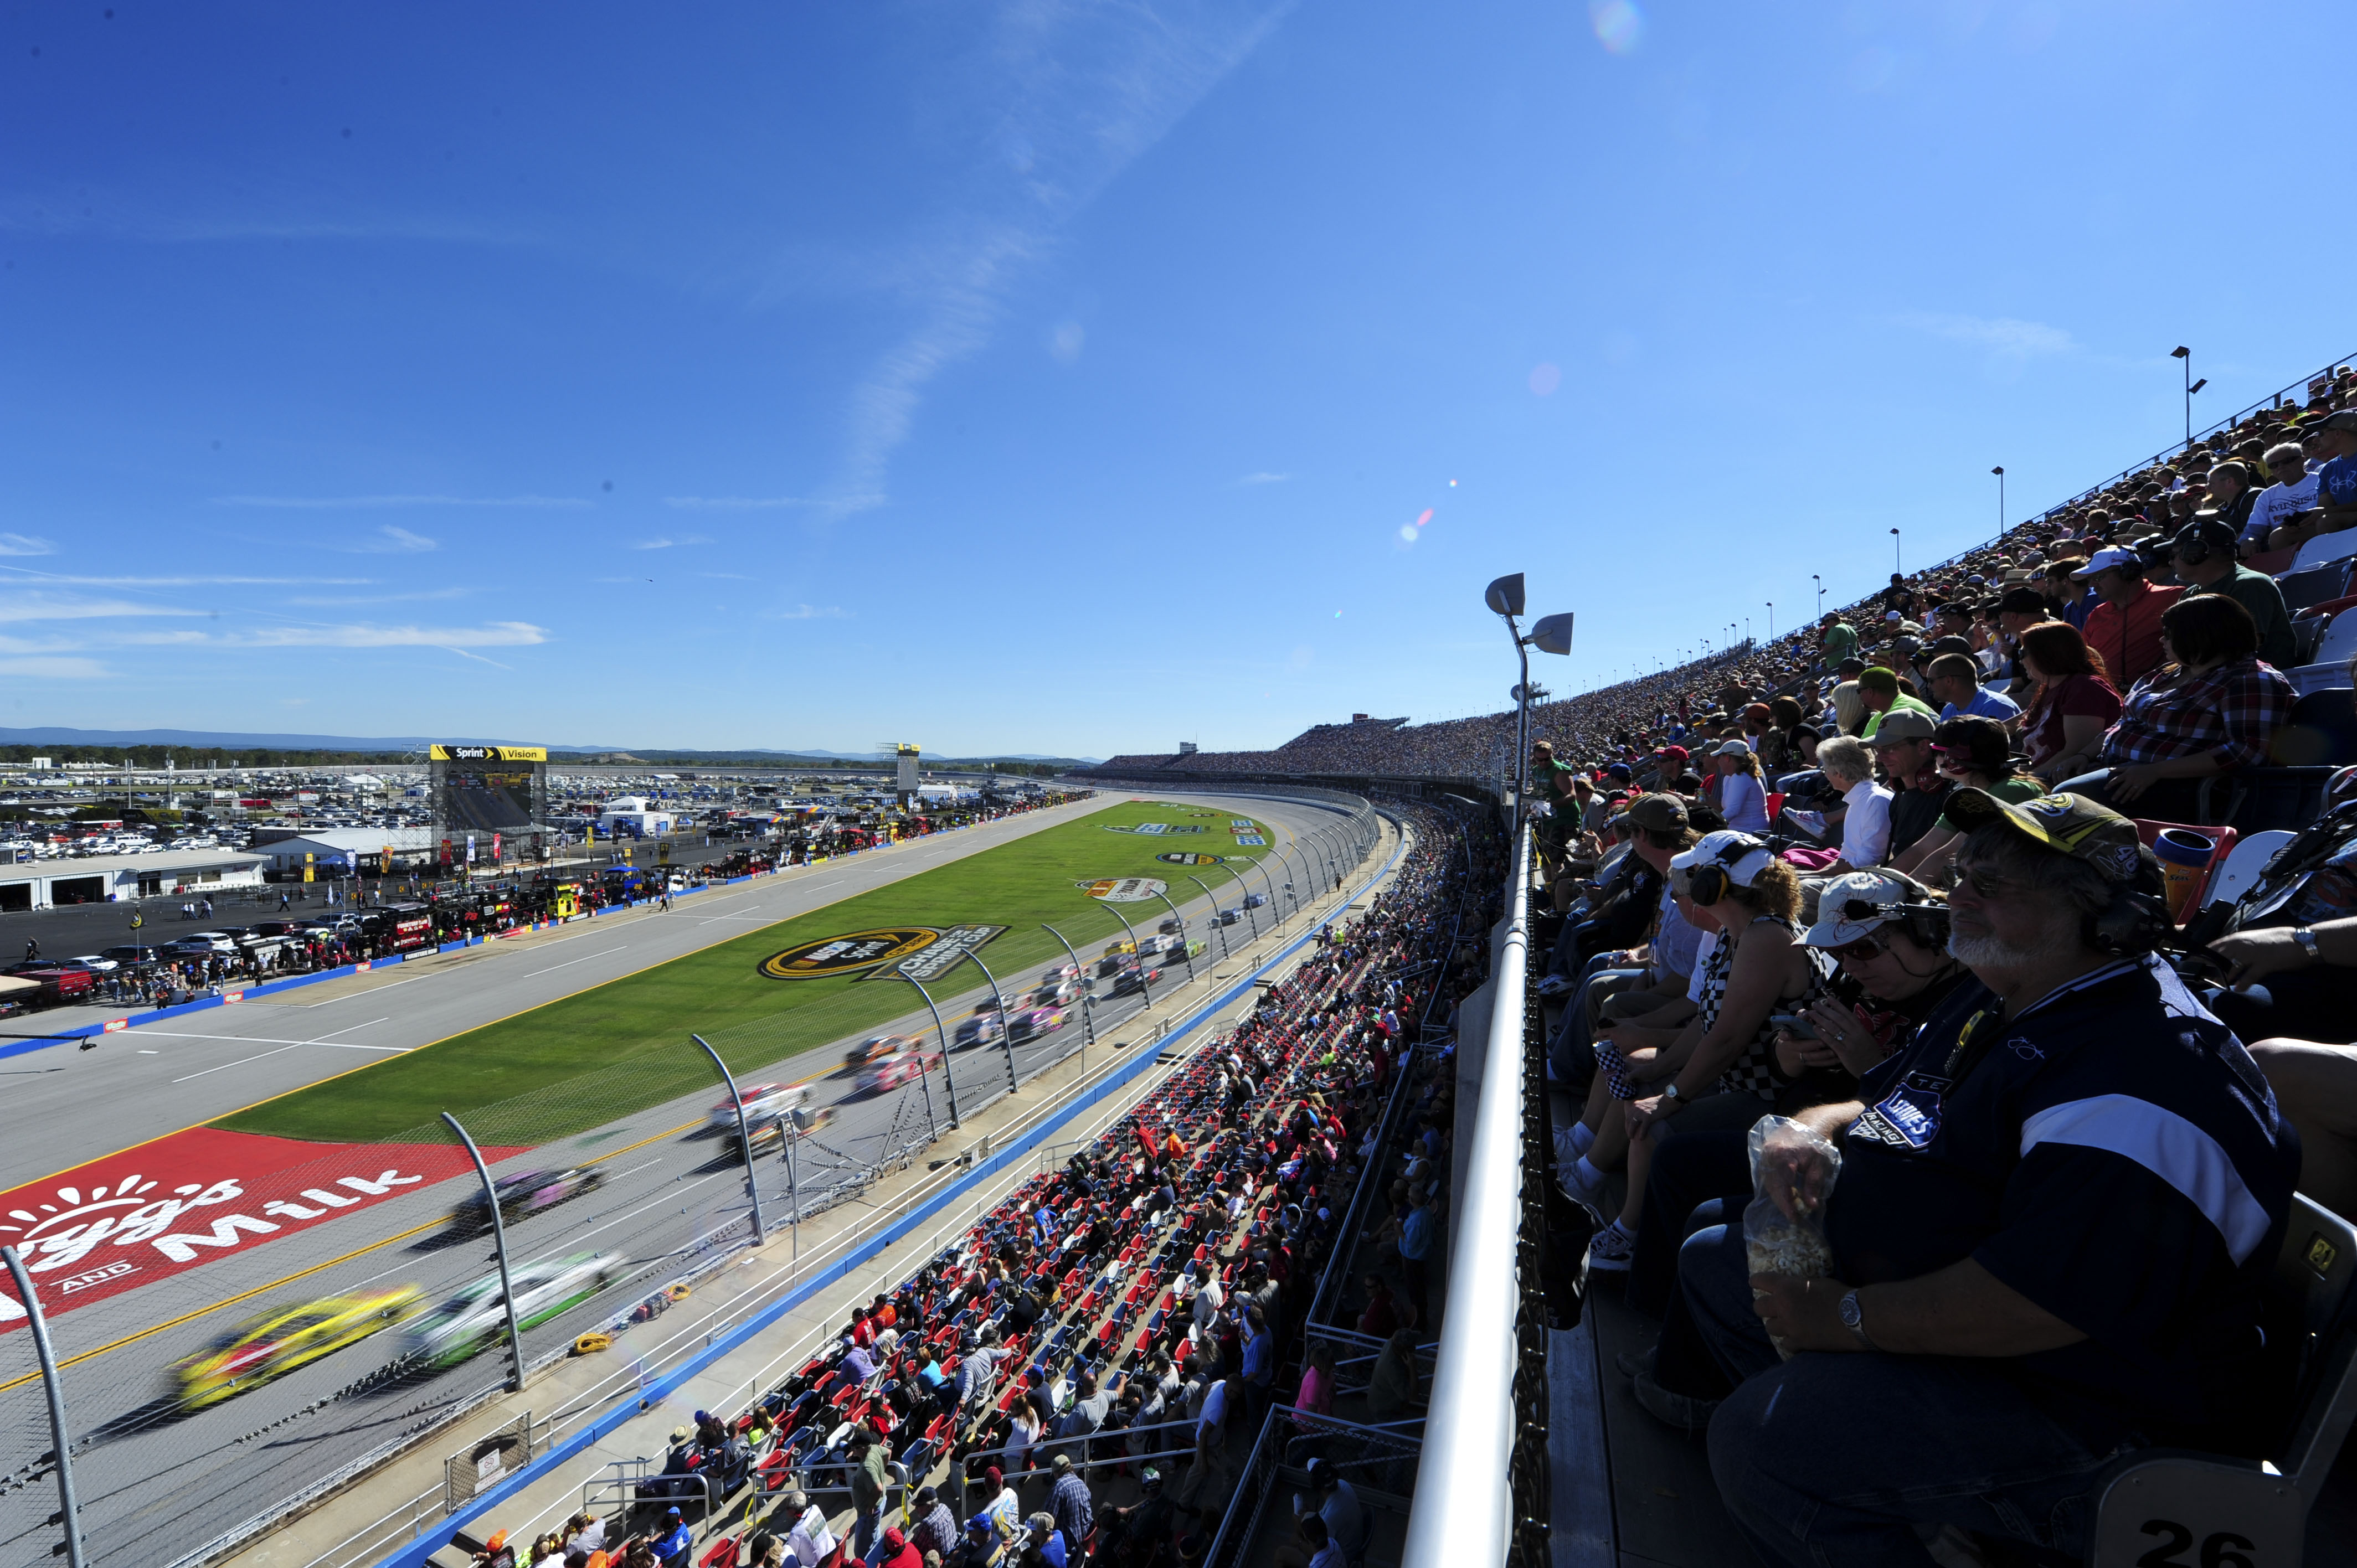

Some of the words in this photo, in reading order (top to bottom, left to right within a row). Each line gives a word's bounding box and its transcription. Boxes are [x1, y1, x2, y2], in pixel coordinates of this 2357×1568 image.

[456, 748, 484, 759] Sprint
[2113, 846, 2141, 874] 48
[810, 941, 857, 961] NASCAR
[841, 941, 890, 960] Sprint
[898, 937, 959, 971] CHASE
[910, 943, 969, 978] SPRINT
[966, 926, 991, 943] CUP
[1866, 1115, 1900, 1141] RACING
[151, 1170, 423, 1262] Milk
[2312, 1243, 2332, 1263] 21
[63, 1263, 132, 1292] AND
[2137, 1519, 2256, 1568] 26
